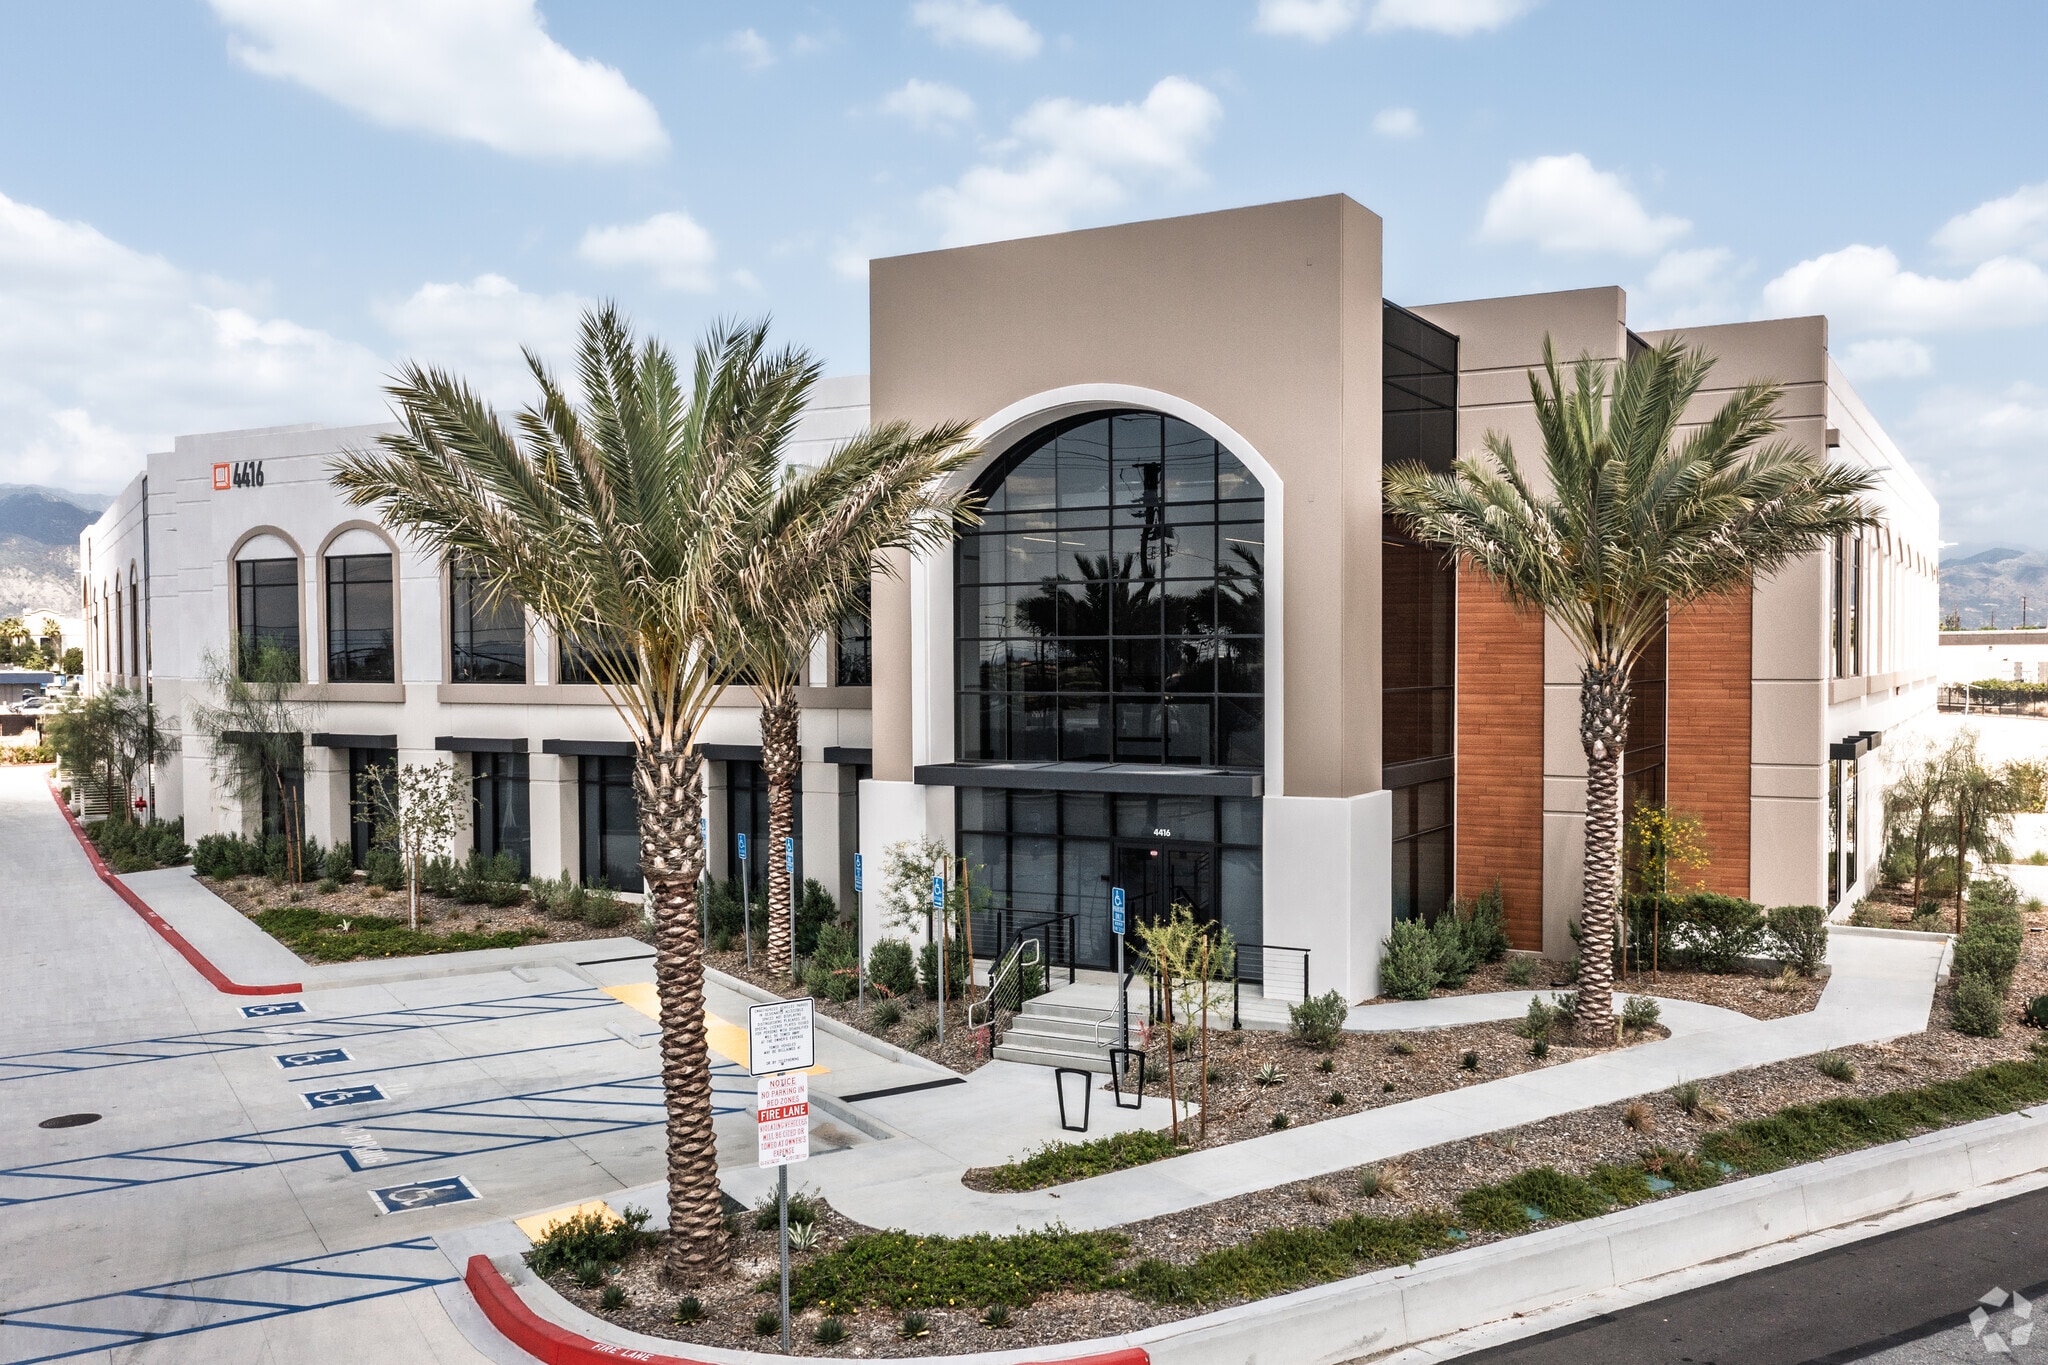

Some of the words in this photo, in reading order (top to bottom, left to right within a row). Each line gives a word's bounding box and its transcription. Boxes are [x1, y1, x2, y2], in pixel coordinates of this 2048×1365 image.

[233, 461, 264, 488] 4416
[770, 1077, 796, 1087] NOTICE
[772, 1087, 797, 1097] PARKING
[767, 1099, 778, 1107] RED
[780, 1096, 800, 1104] ZONES
[760, 1108, 780, 1122] FIRE
[784, 1104, 806, 1118] LANE
[760, 1122, 784, 1132] VIOLATING
[785, 1118, 807, 1128] VEHICLES
[763, 1133, 774, 1141] WILL
[783, 1129, 796, 1137] CITED
[344, 1134, 389, 1163] PARKING
[761, 1141, 777, 1150] TOWED
[785, 1136, 806, 1146] OWNER'S
[773, 1147, 794, 1157] EXPENSE
[592, 1344, 620, 1354] FIRE
[621, 1348, 654, 1361] LANE
